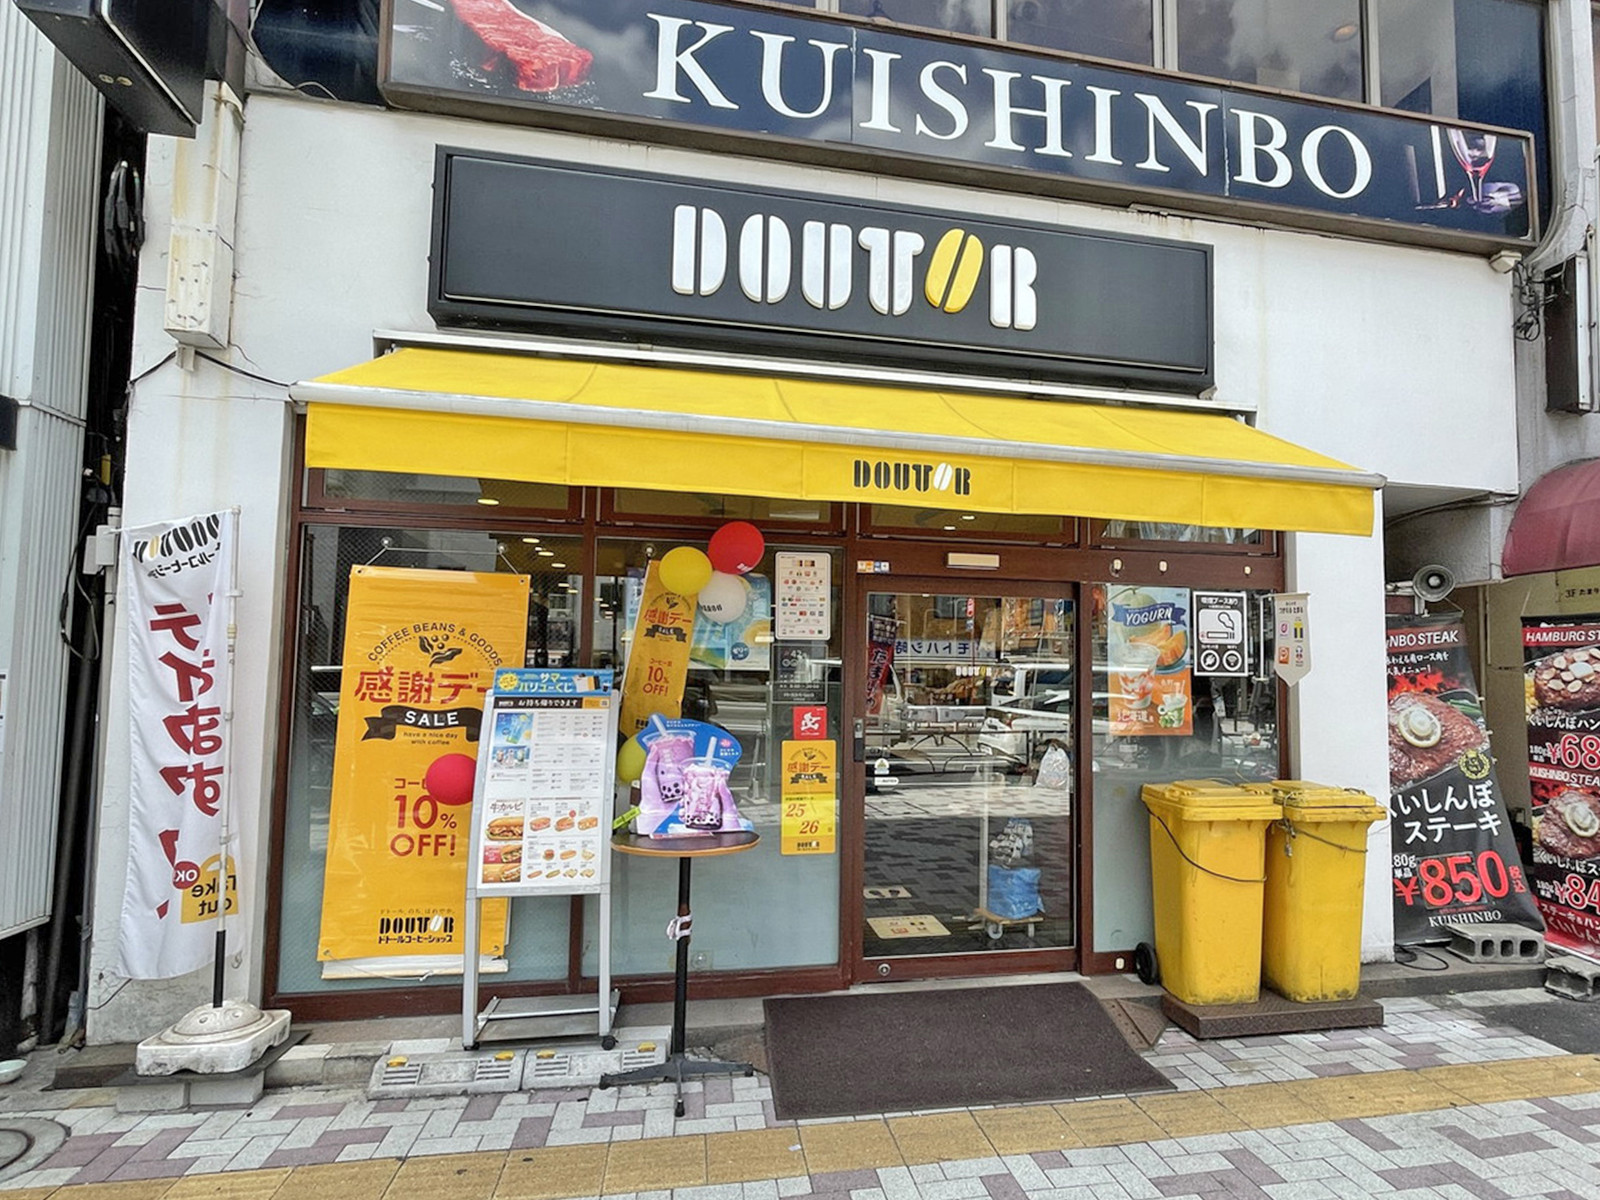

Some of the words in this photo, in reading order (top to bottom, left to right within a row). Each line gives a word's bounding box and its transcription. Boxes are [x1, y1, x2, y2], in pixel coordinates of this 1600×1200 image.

[643, 13, 1372, 199] KUISHINBO
[671, 204, 1038, 331] DOUTOR
[853, 459, 971, 496] DOUTOR
[367, 627, 411, 662] COFFEE
[413, 622, 456, 633] BEANS
[458, 627, 467, 637] &
[469, 632, 504, 666] GOODS
[1386, 633, 1417, 648] NBO
[1418, 630, 1459, 645] STEAK
[1526, 630, 1586, 643] HAMBURG
[404, 710, 459, 727] SALE
[394, 794, 457, 830] 10%
[785, 803, 807, 818] 25
[799, 820, 820, 835] 26
[1403, 811, 1502, 845] ステーキ
[390, 834, 456, 857] OFF!
[1391, 854, 1417, 869] 80g
[1393, 850, 1510, 907] ¥850
[379, 915, 455, 934] DOUTOR
[1428, 910, 1502, 928] KUISHINBO
